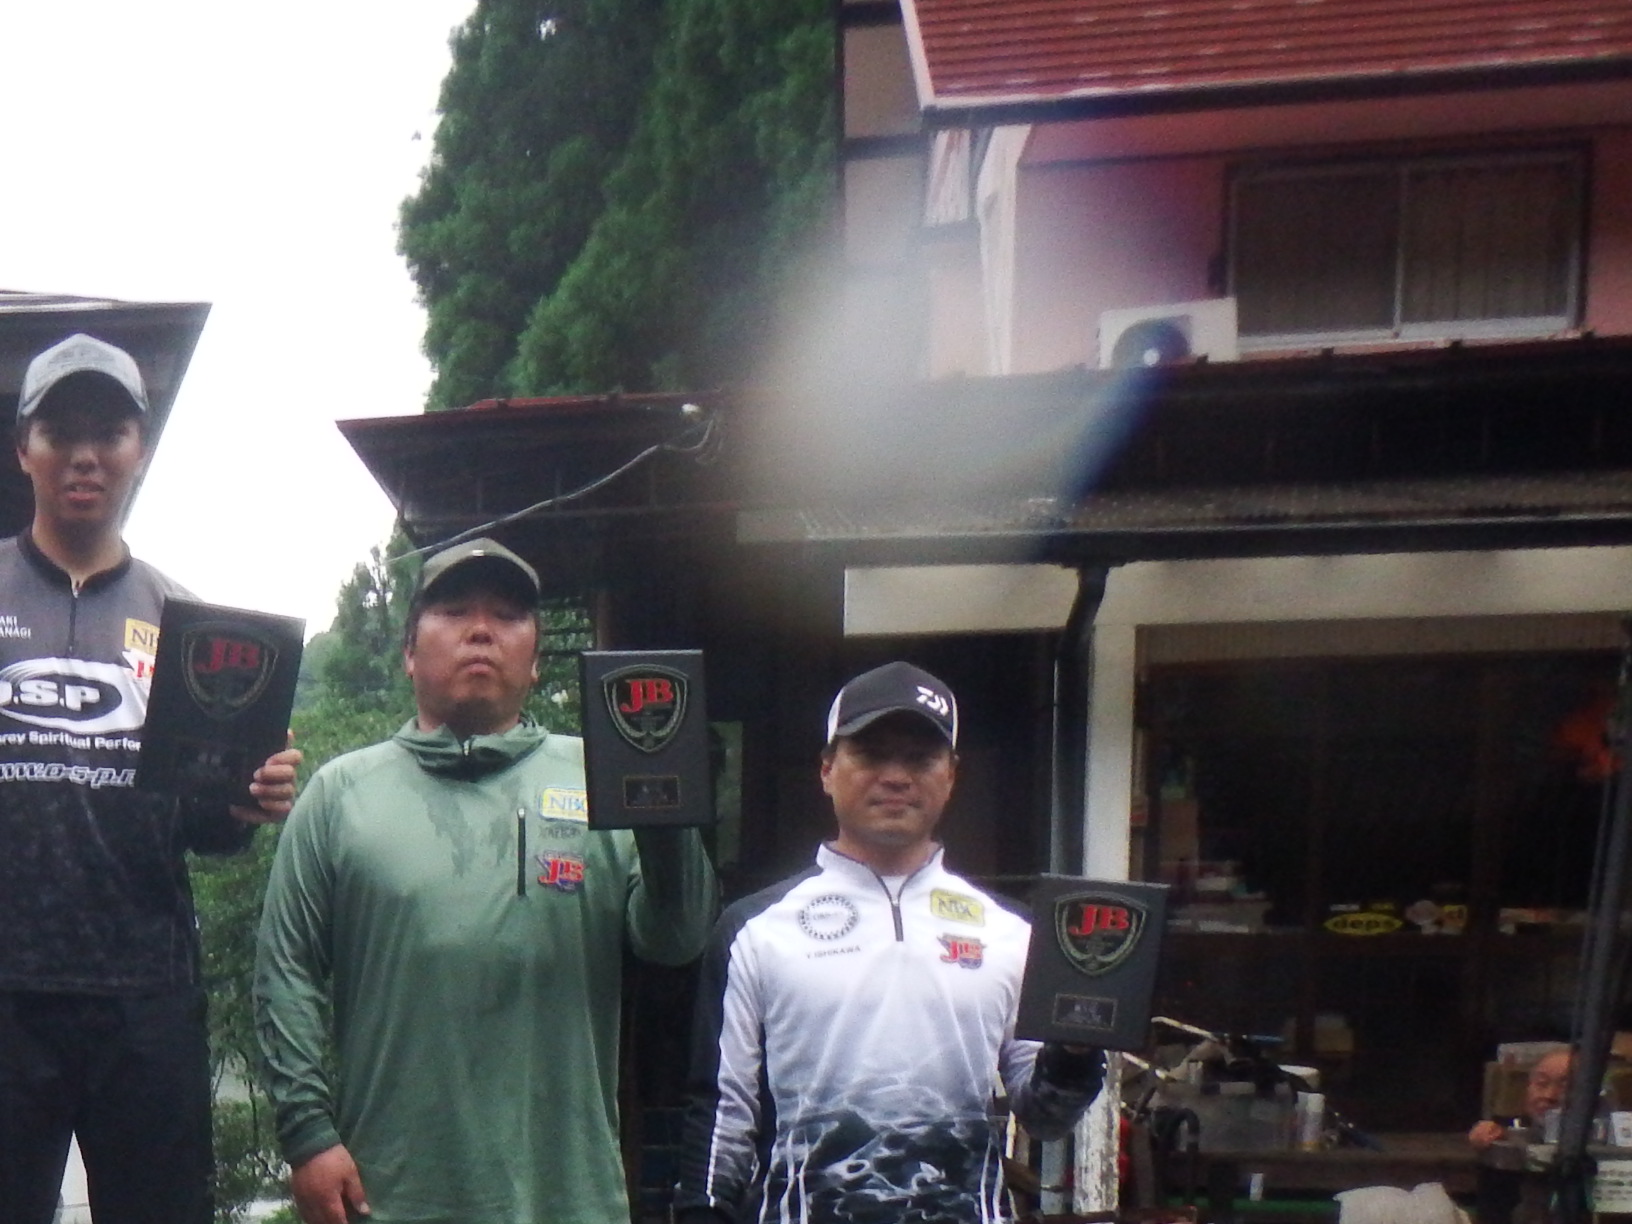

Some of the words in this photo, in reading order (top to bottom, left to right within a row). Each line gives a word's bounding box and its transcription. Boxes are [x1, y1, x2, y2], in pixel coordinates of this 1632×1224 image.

[193, 637, 262, 673] JB
[619, 677, 674, 714] JB
[29, 730, 91, 749] Spiritual
[94, 736, 142, 752] Perfor
[537, 859, 585, 885] JB
[1069, 903, 1130, 936] JB
